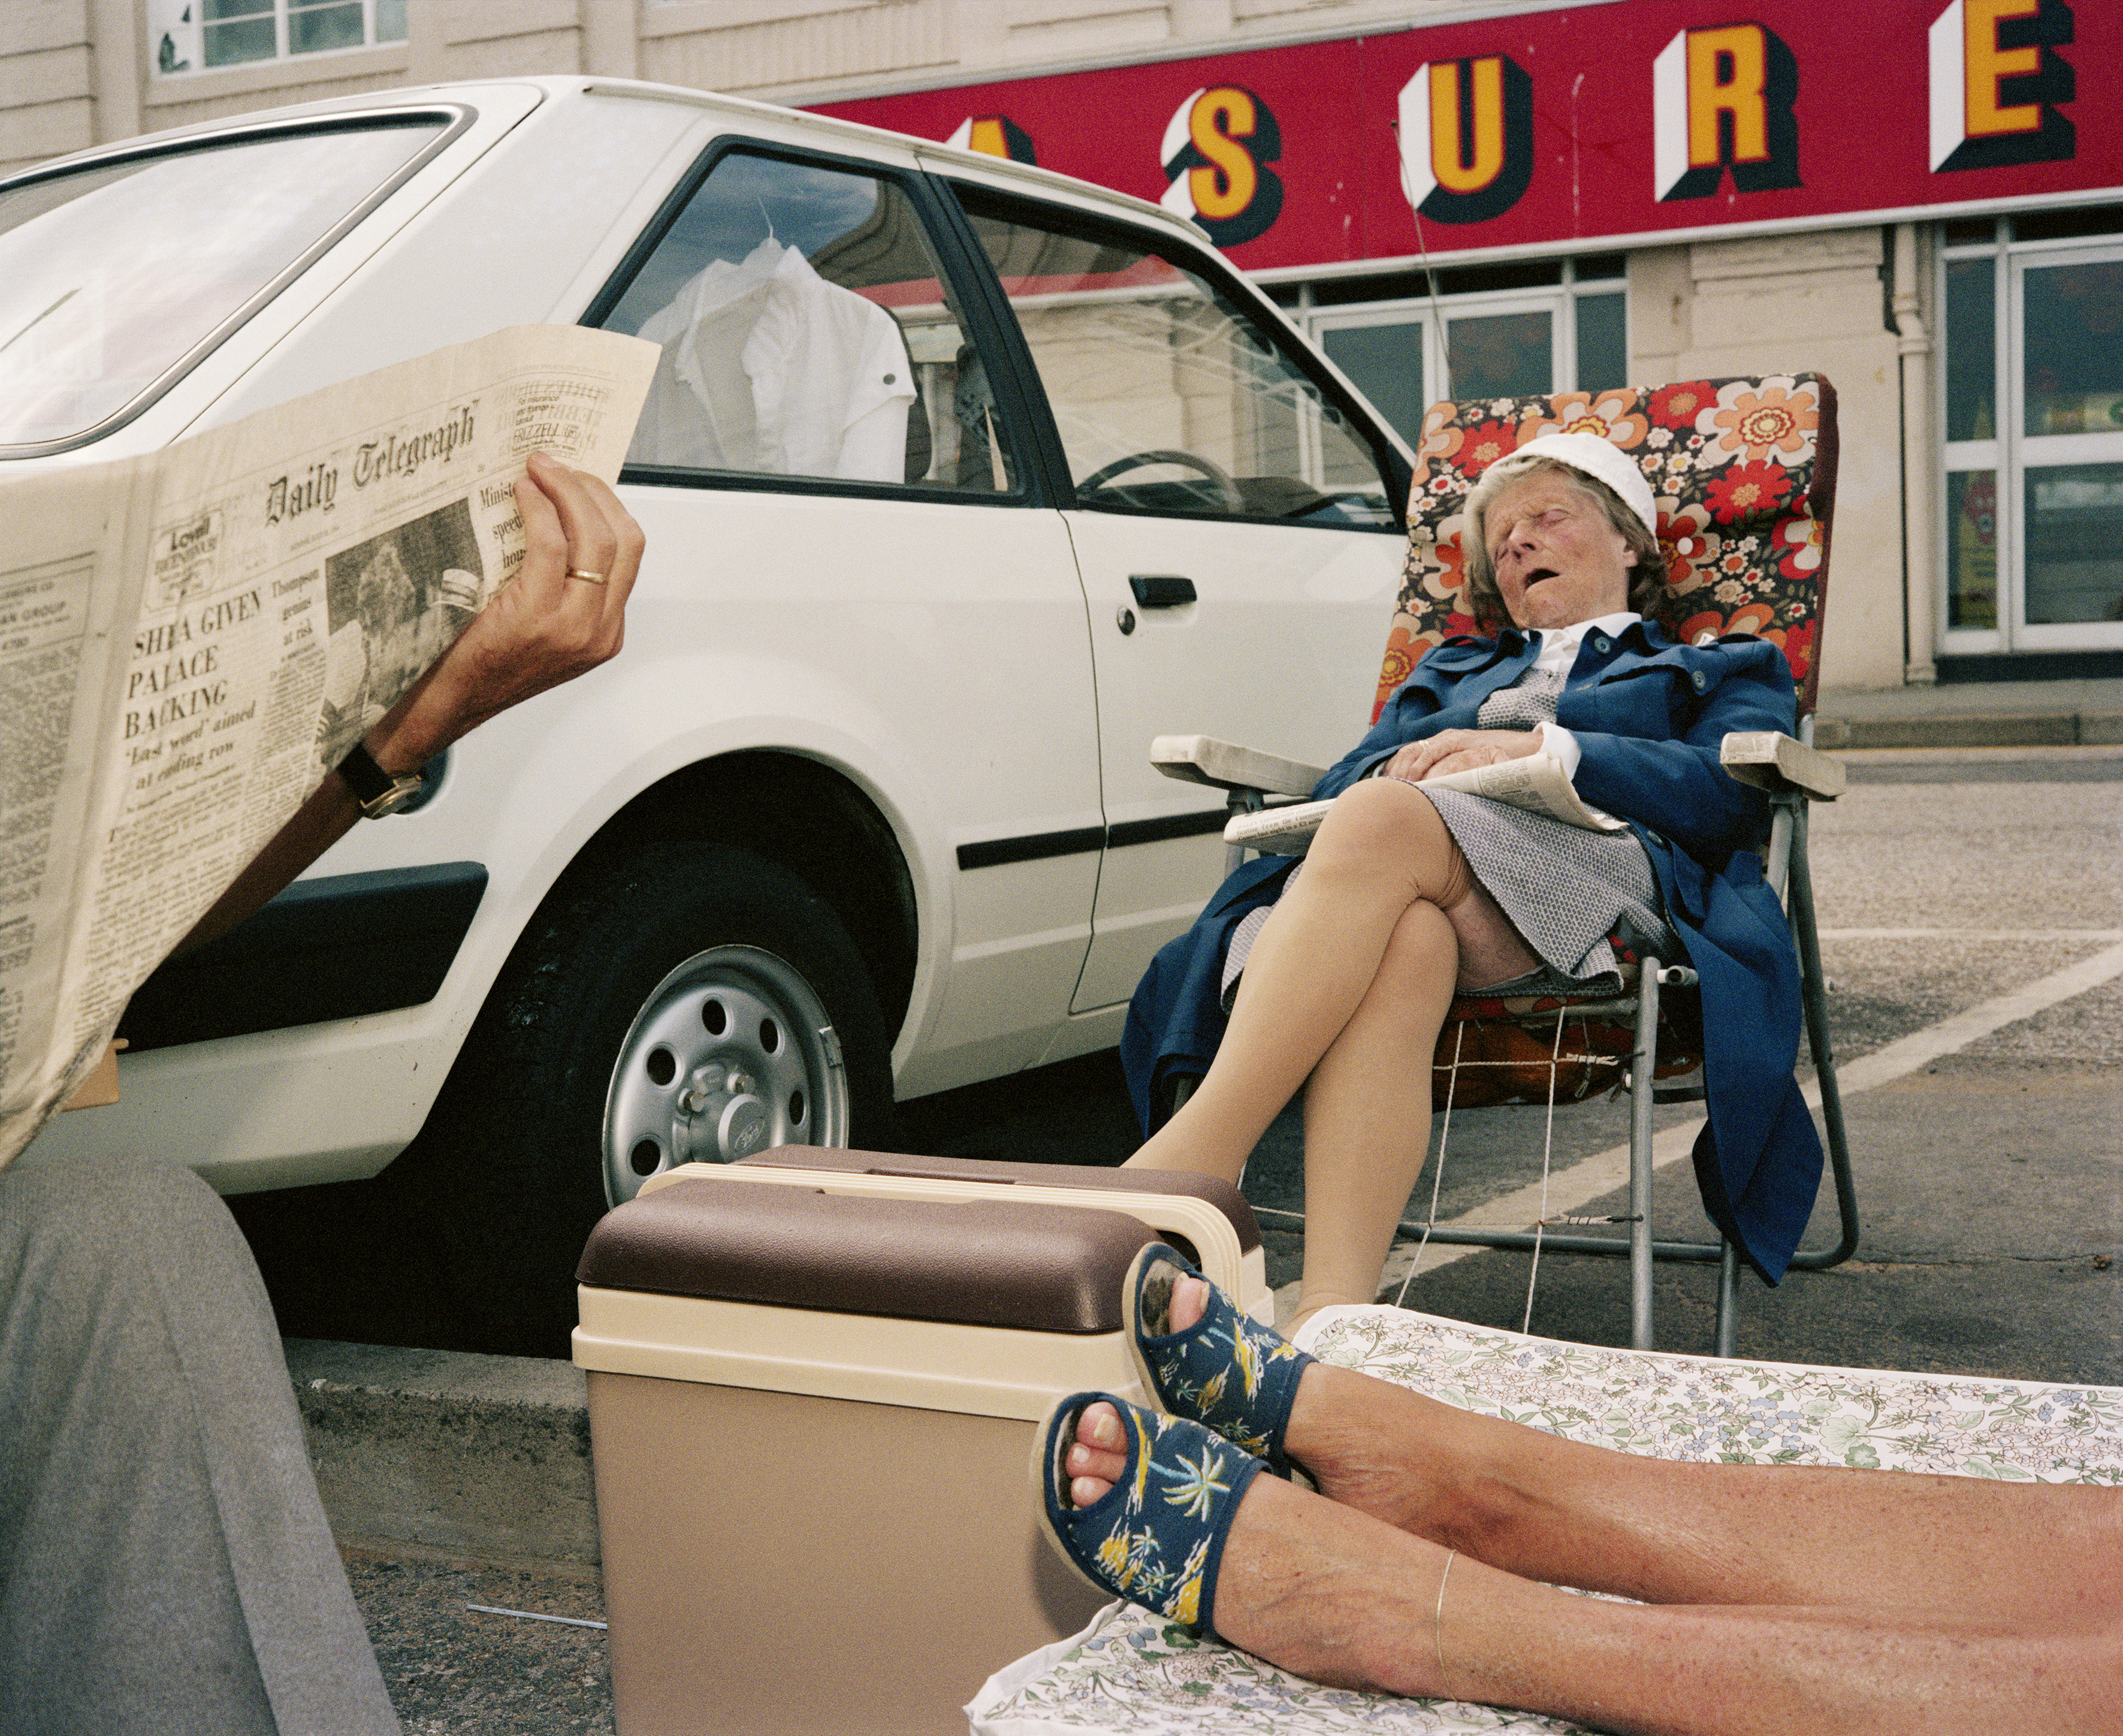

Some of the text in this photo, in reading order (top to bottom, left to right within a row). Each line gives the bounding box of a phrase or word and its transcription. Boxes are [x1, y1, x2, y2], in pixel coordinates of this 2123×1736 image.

[946, 0, 2077, 249] SURE
[514, 422, 561, 442] FRIZZELL
[265, 463, 339, 529] Daily
[354, 398, 479, 491] Telegraph
[132, 617, 192, 660] SHEA
[201, 586, 262, 635] GIVEN
[128, 644, 219, 701] PALACE
[124, 678, 229, 739] BACKING
[209, 740, 235, 760] row
[1261, 822, 1280, 830] from
